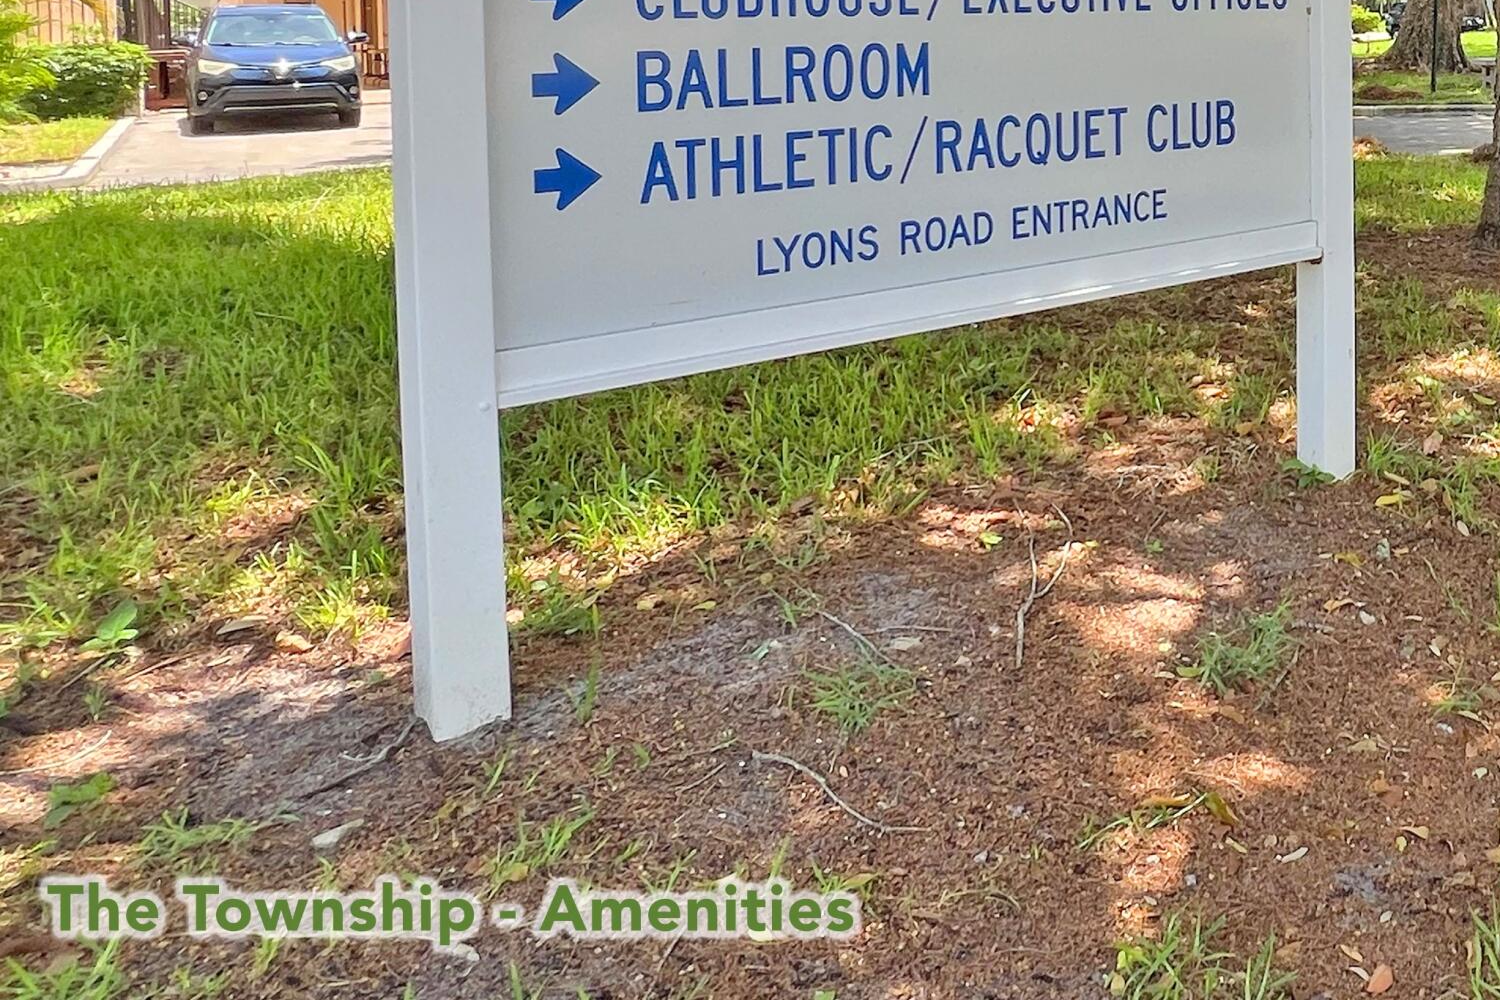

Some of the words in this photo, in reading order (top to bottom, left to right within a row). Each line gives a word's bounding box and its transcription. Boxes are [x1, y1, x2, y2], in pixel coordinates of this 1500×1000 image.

[635, 42, 931, 113] BALLROOM
[1146, 100, 1237, 152] CLUB
[756, 224, 879, 277] LYONS
[899, 212, 993, 256] ROAD
[1011, 189, 1168, 240] ENTRANCE
